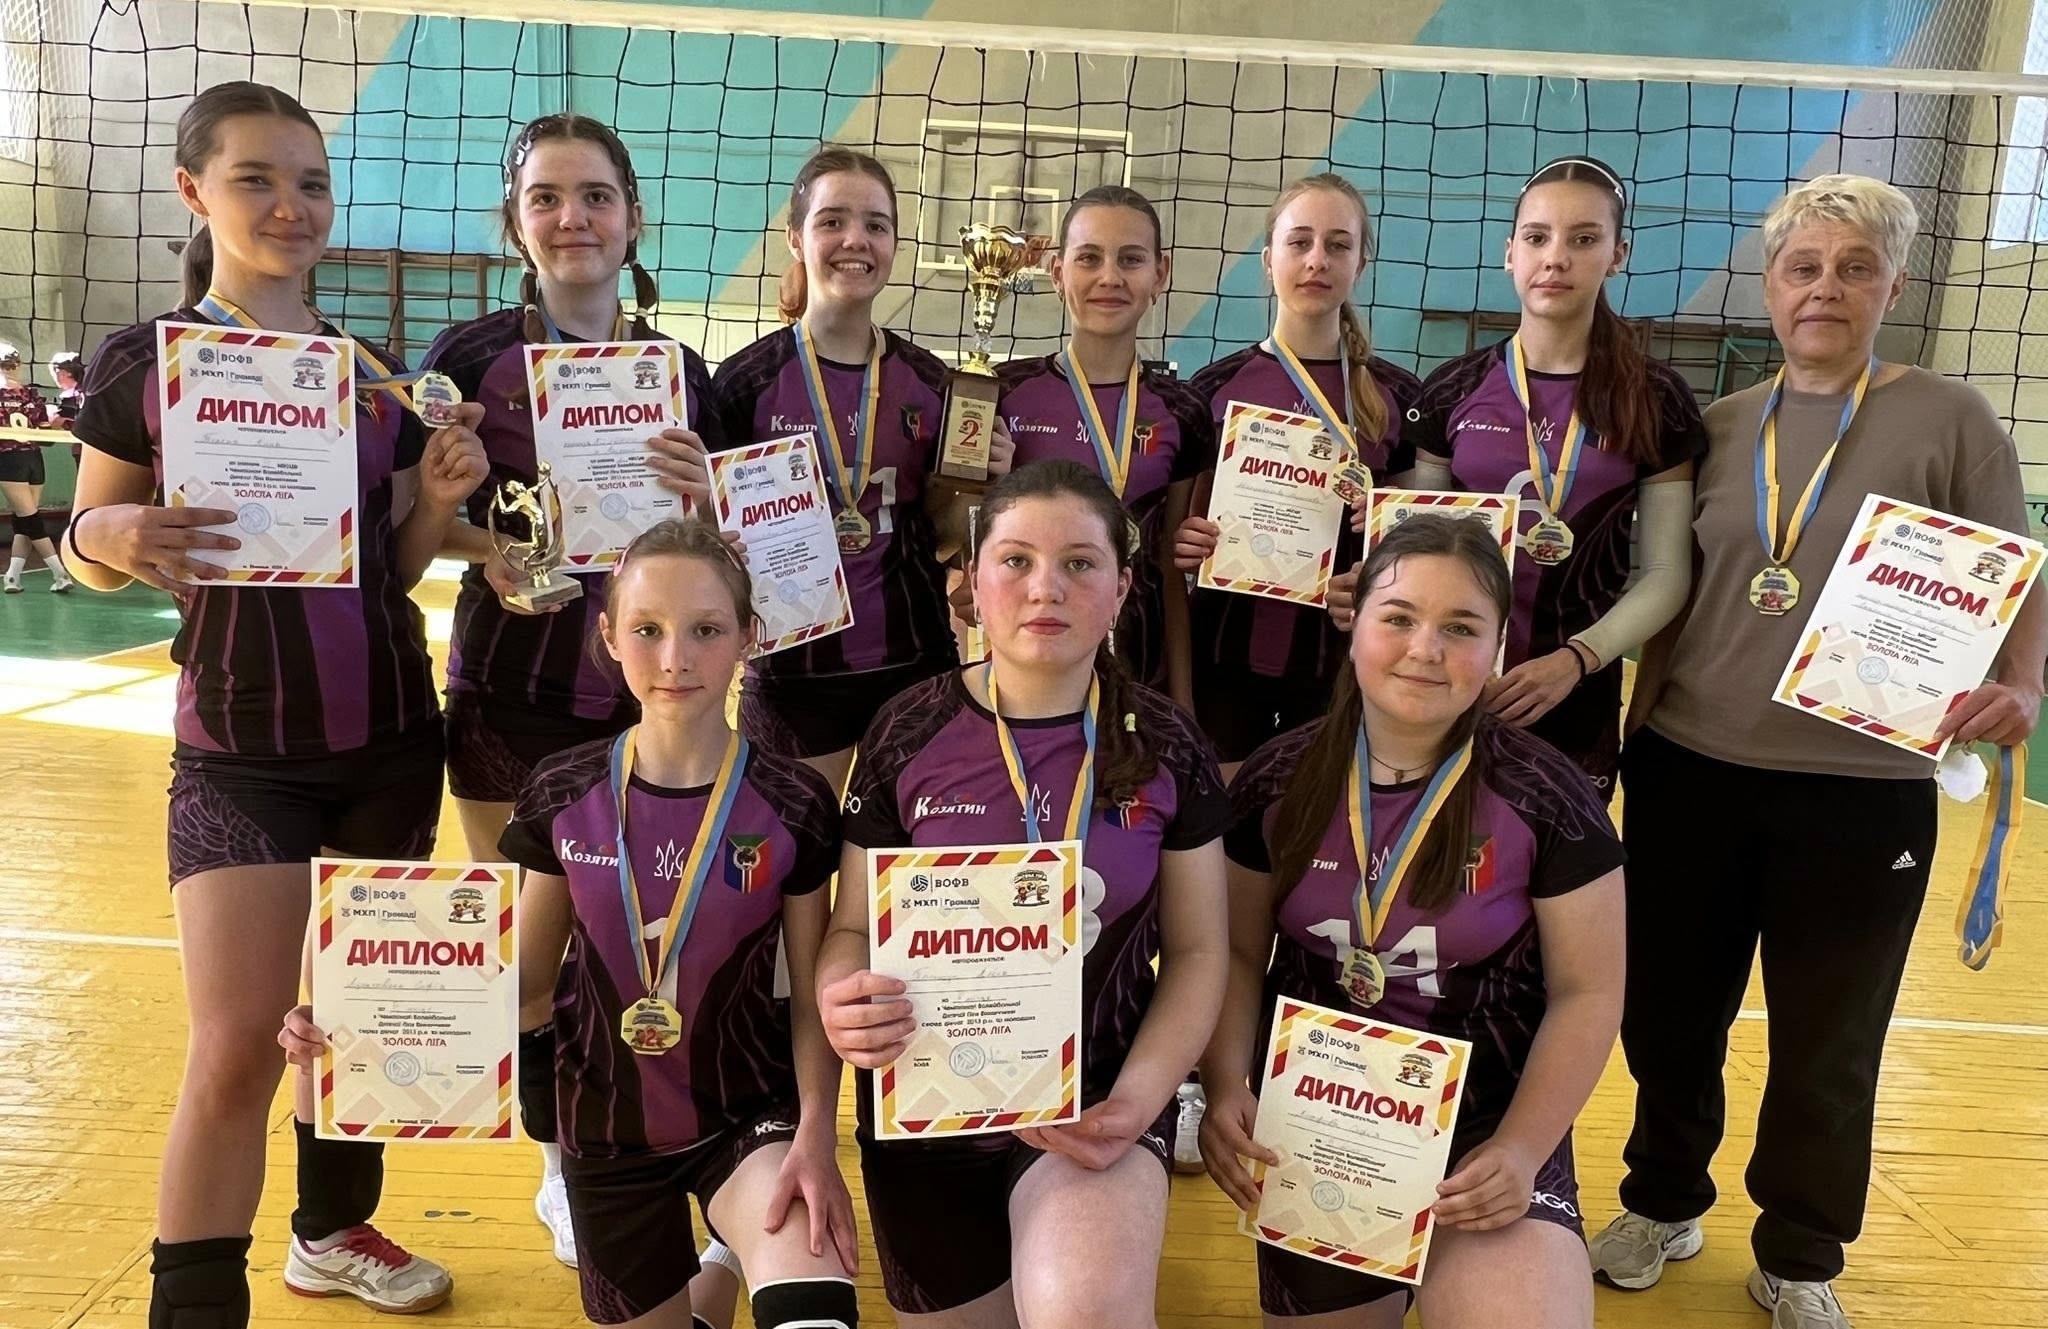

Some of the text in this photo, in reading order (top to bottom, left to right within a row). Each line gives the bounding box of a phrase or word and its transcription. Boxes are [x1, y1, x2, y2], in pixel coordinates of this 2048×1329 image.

[221, 354, 253, 364] ВОФВ
[196, 397, 326, 429] ДИПЛОМ
[562, 403, 664, 430] ДИПЛОМ
[771, 415, 818, 432] Козяти
[960, 420, 979, 447] 2
[1239, 456, 1327, 488] ДИПЛОМ
[234, 489, 294, 500] ЗОЛОТА ЛІГА
[741, 491, 815, 528] ДИПЛОМ
[1914, 532, 1944, 547] ВОФВ
[1866, 562, 1989, 617] ДИПЛОМ
[914, 796, 987, 819] Козятин
[561, 838, 619, 867] Козяти
[935, 878, 969, 888] ВОФВ
[373, 890, 406, 900] ВОФВ
[914, 899, 938, 907] МХП
[353, 909, 376, 917] МХП
[908, 924, 1048, 959] ДИПЛОМ
[347, 939, 484, 967] ДИПЛОМ
[1306, 918, 1446, 998] 14
[382, 1037, 447, 1047] ЗОЛОТА ЛІГА
[645, 1026, 658, 1046] 2
[946, 1026, 1011, 1038] ЗОЛОТА ЛІГА
[1307, 1049, 1330, 1060] МХП
[1329, 1038, 1360, 1053] ВОФВ
[1294, 1075, 1425, 1127] ДИПЛОМ
[1313, 1165, 1373, 1188] ЗОЛОТА ЛІГА
